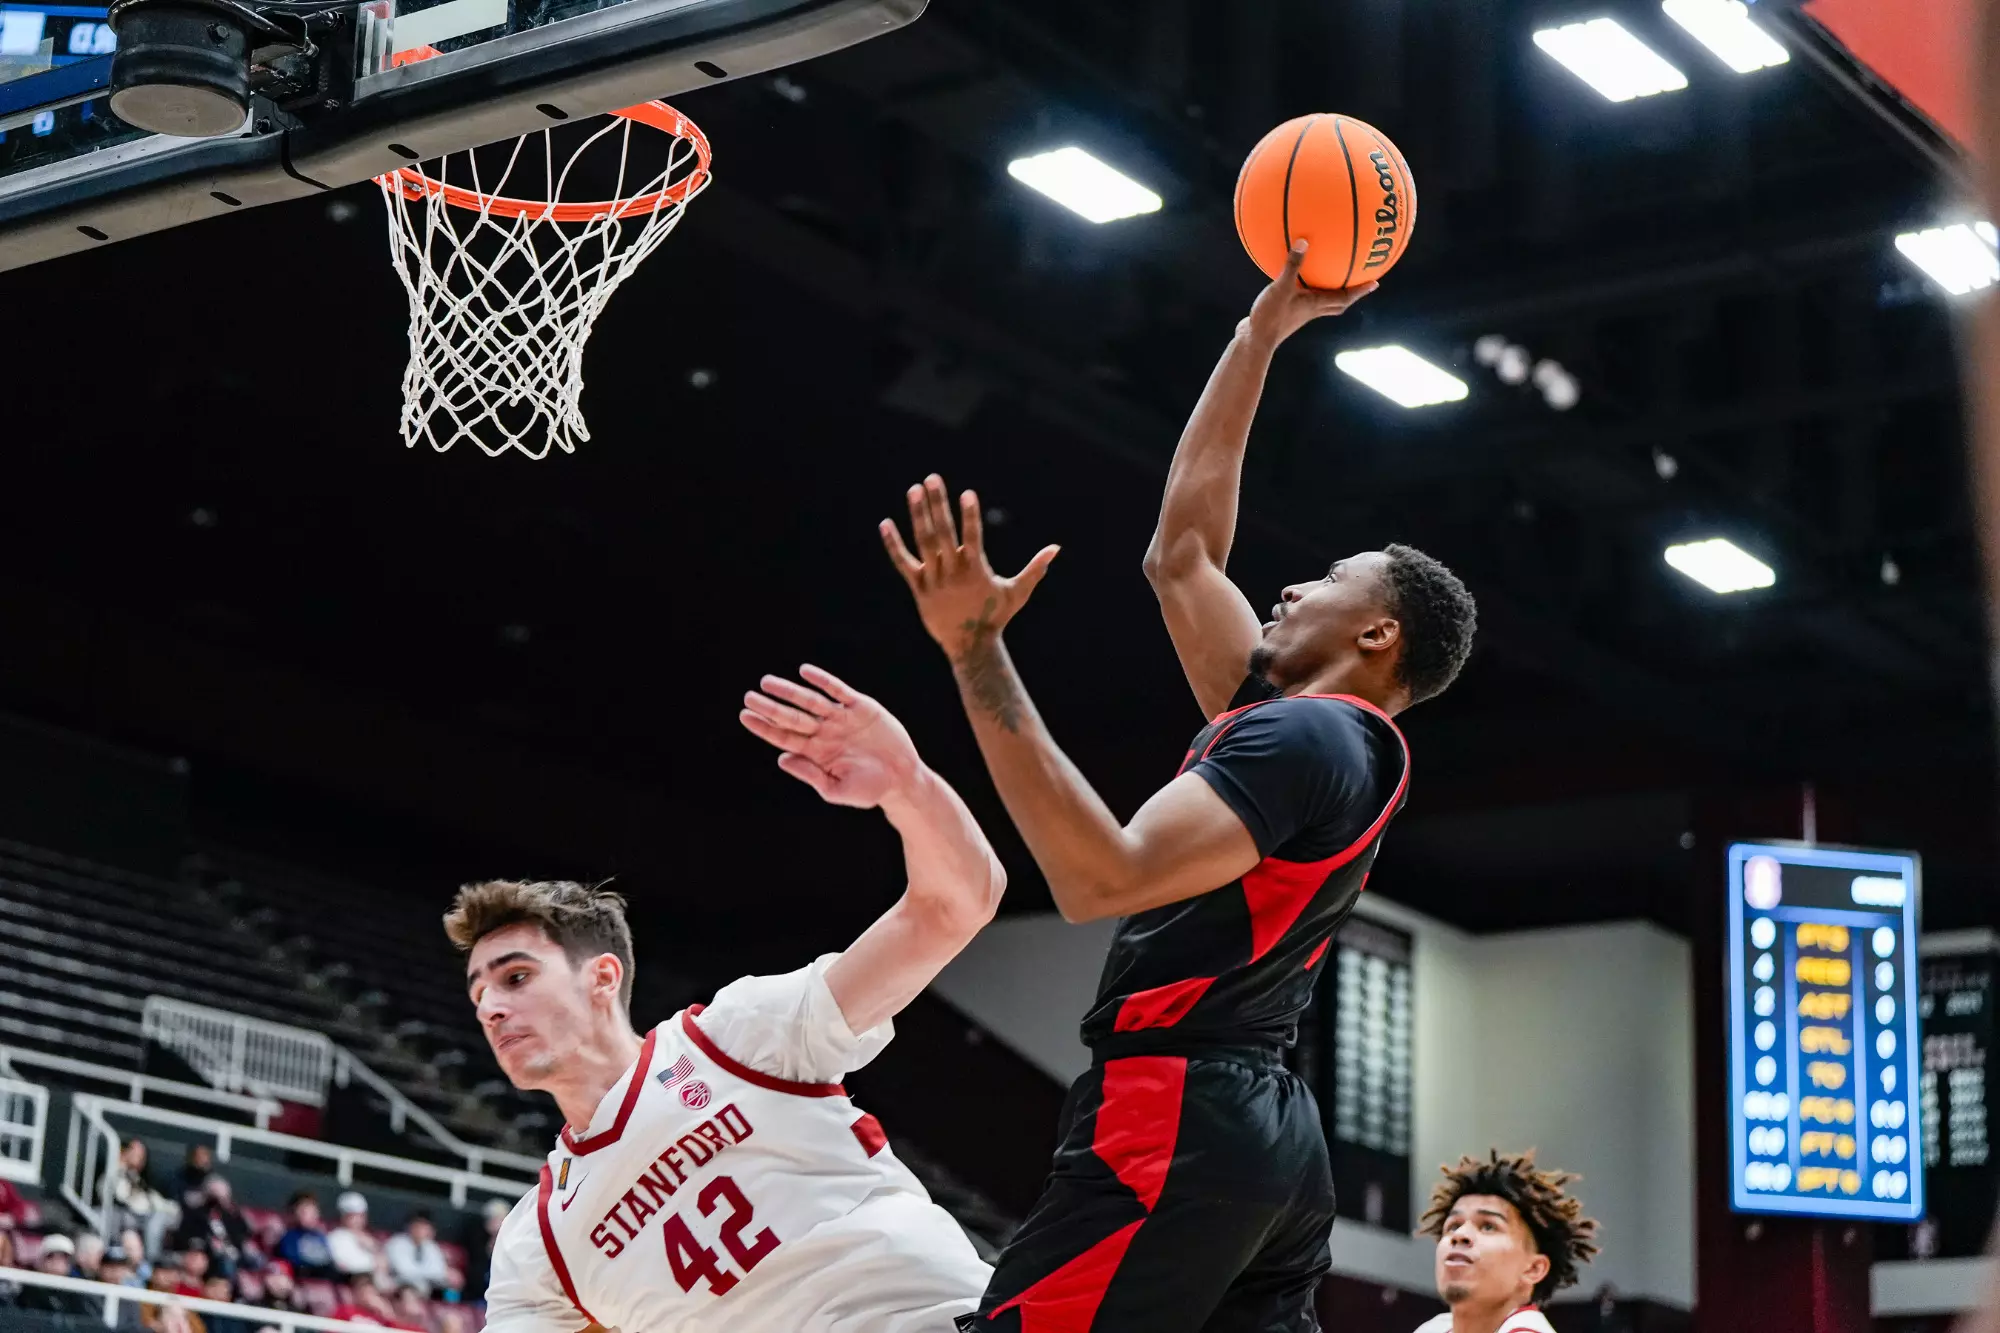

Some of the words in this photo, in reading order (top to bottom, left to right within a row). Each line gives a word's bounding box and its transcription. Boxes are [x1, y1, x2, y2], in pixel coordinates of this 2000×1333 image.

[1363, 149, 1399, 270] Wilson
[589, 1103, 754, 1259] STANFORD
[663, 1175, 782, 1297] 42
